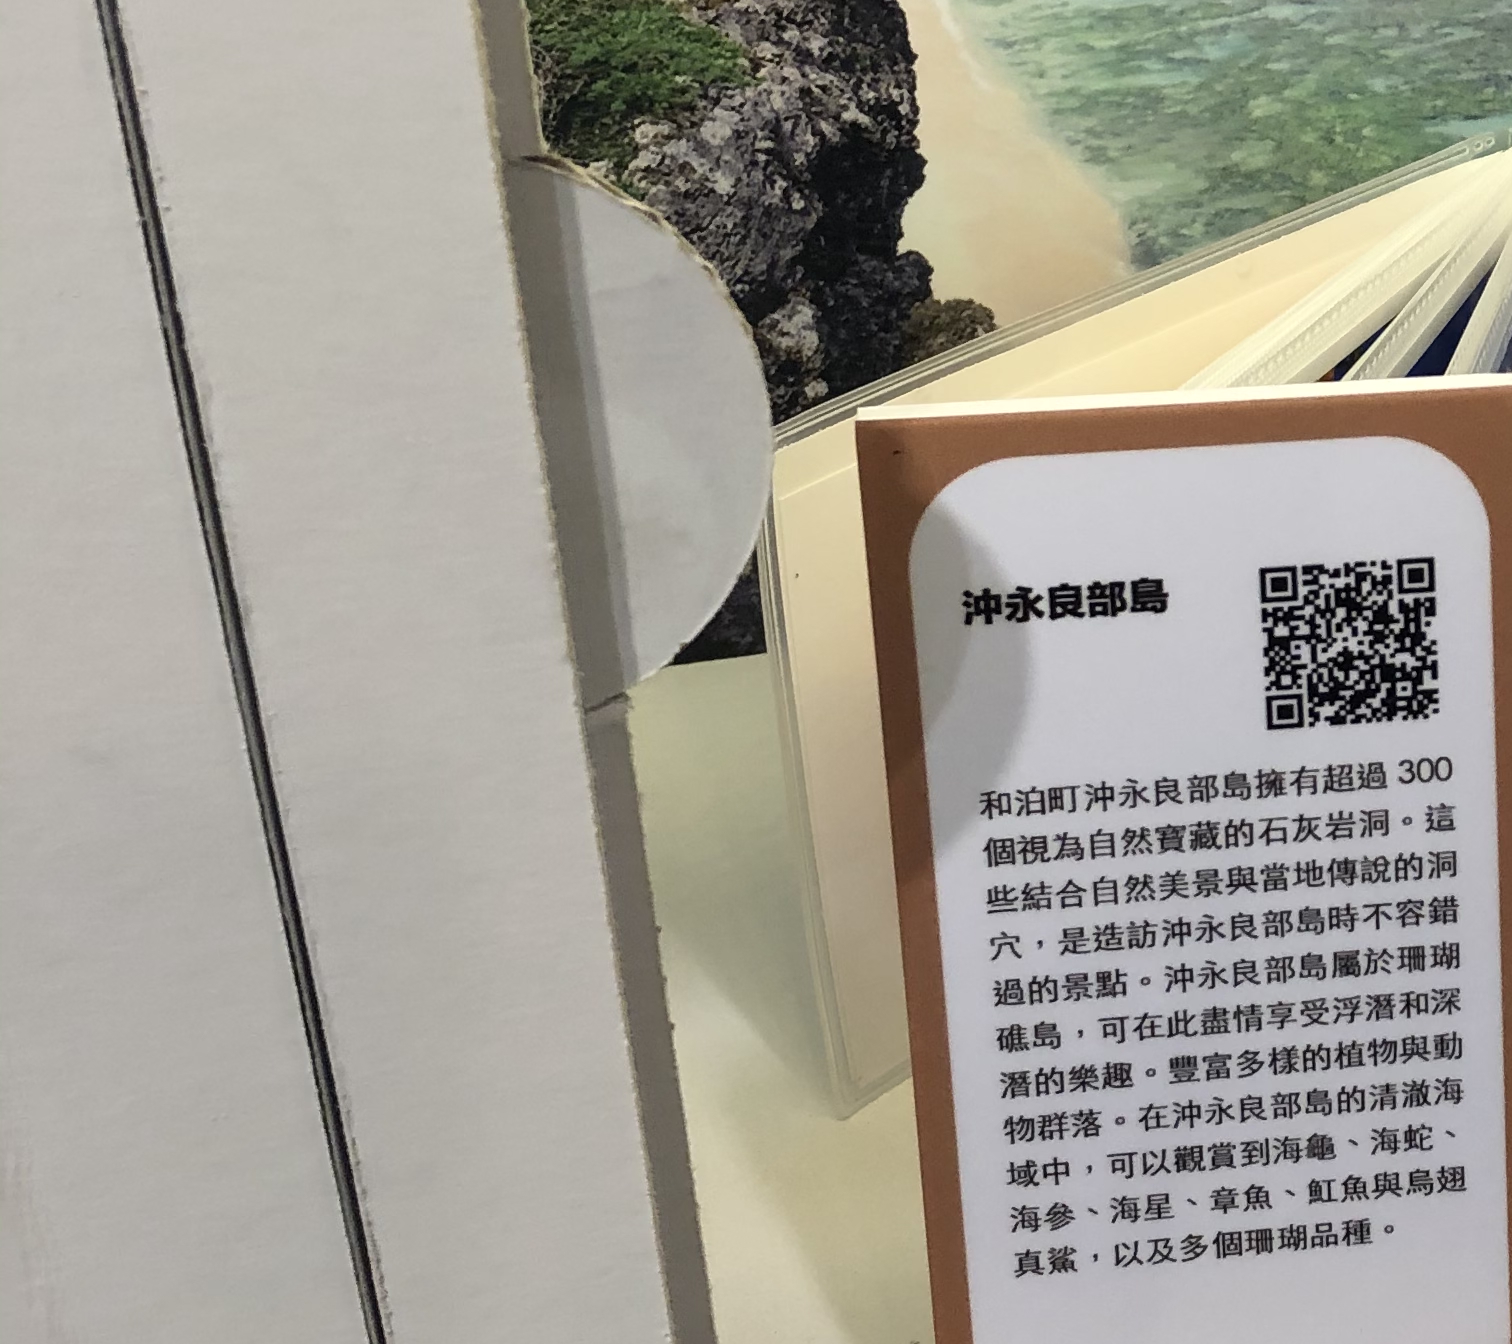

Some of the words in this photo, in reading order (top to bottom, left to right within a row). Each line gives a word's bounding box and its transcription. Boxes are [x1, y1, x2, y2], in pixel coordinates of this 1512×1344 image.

[962, 577, 1169, 626] 沖永良部島
[980, 761, 1389, 820] 和泊町沖永良部島擁有超過
[1397, 756, 1454, 785] 300
[982, 802, 1457, 869] 個視為自然寶藏的石灰岩洞。這
[986, 849, 1458, 914] 些結合自然美景與當地傳說的洞
[993, 941, 1460, 1007] 過的景點。沖永良部島屬於珊瑚
